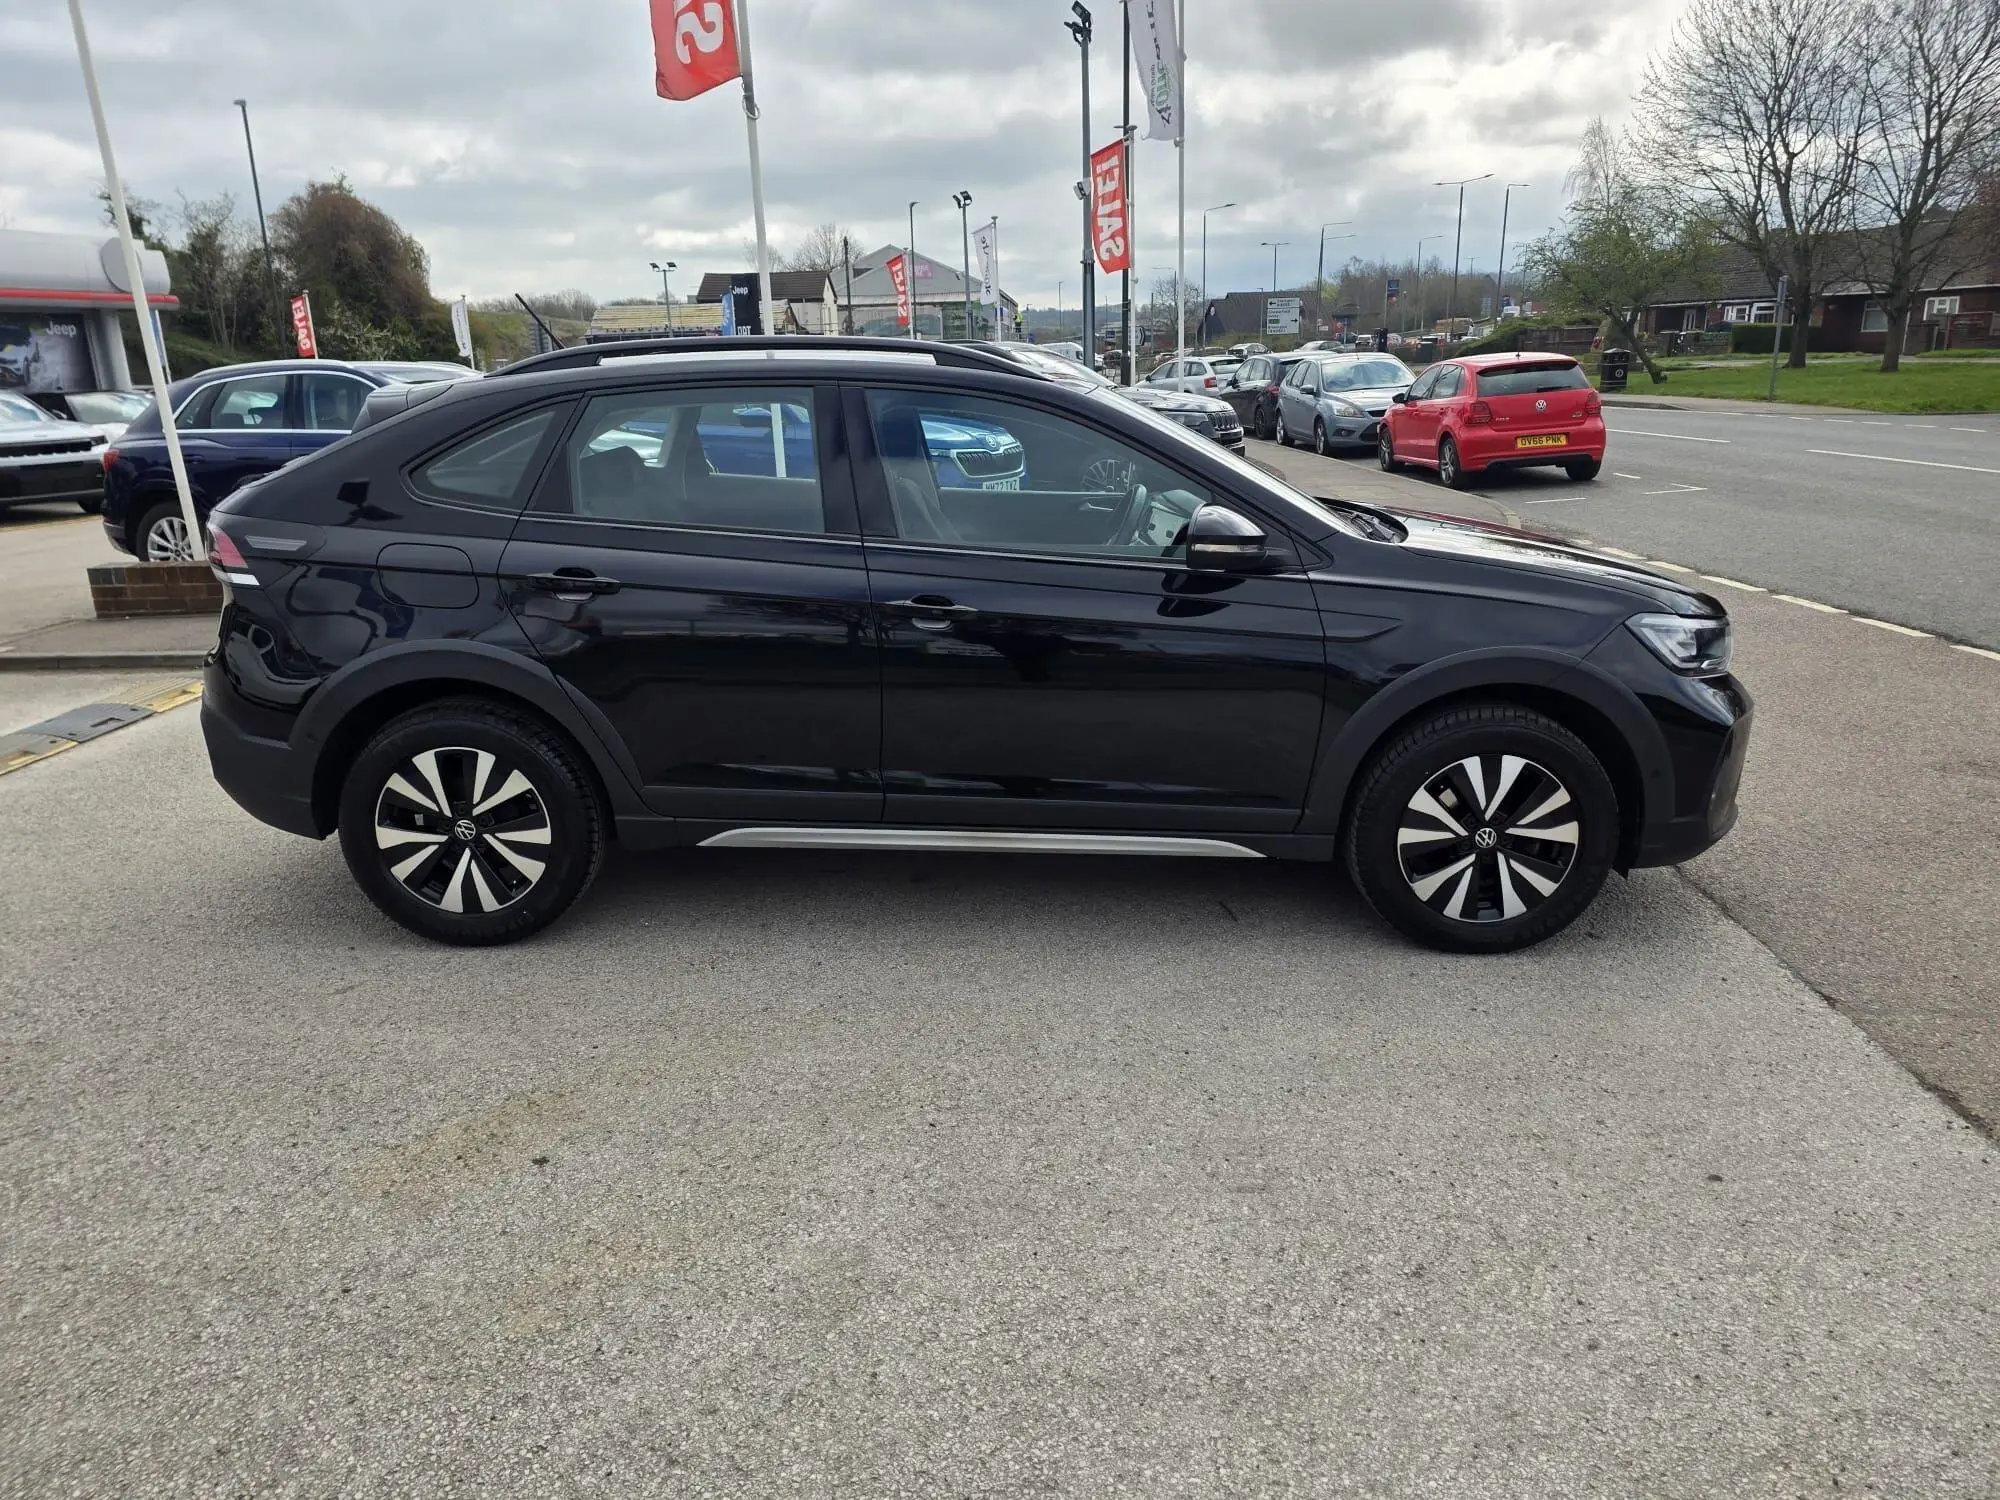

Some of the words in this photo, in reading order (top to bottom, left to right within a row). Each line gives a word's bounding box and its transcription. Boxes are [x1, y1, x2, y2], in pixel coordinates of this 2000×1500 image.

[732, 285, 749, 295] Jeep
[46, 320, 77, 338] Jeep
[1520, 436, 1544, 446] OV66
[1545, 435, 1563, 444] PNK
